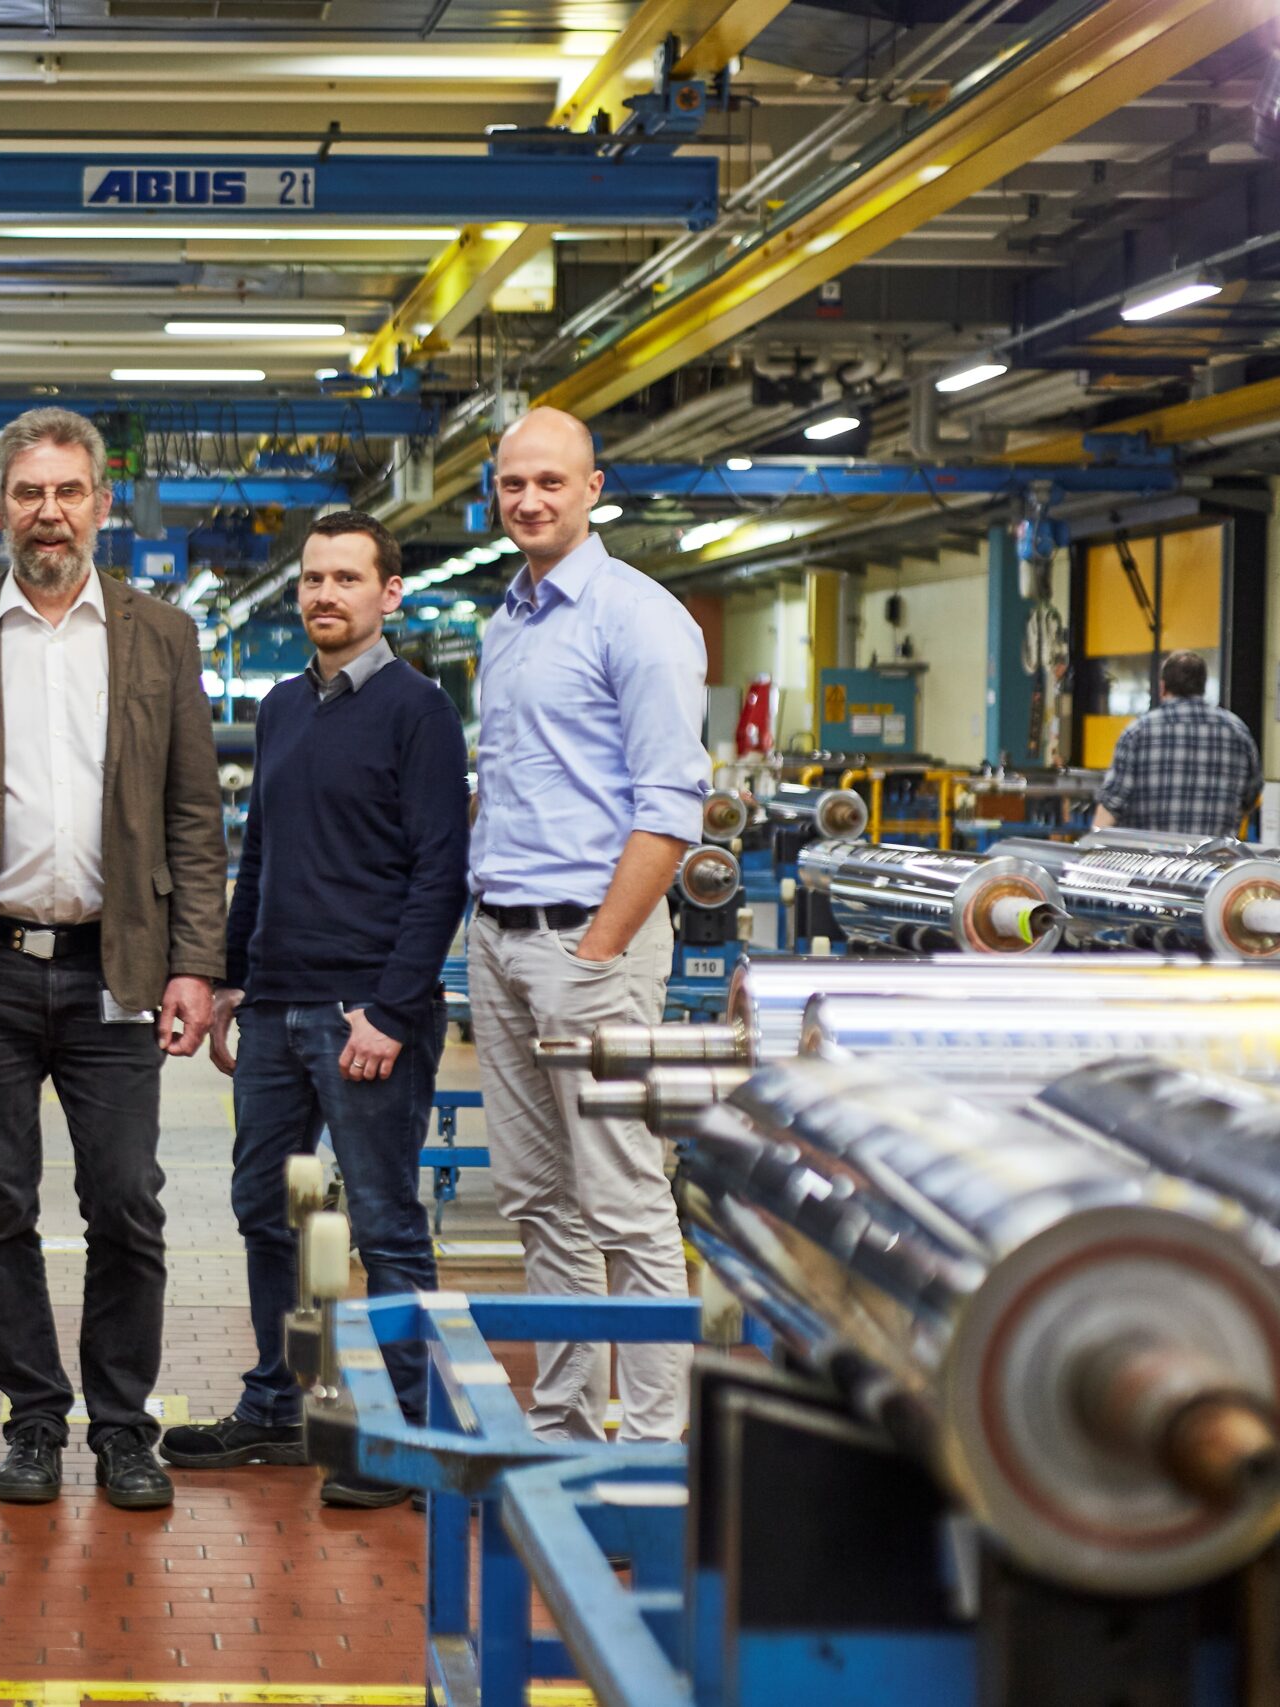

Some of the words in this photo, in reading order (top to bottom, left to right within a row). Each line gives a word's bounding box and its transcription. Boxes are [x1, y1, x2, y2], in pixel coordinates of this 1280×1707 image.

[88, 170, 247, 204] ABUS
[279, 171, 310, 205] 2t
[694, 961, 717, 974] 110
